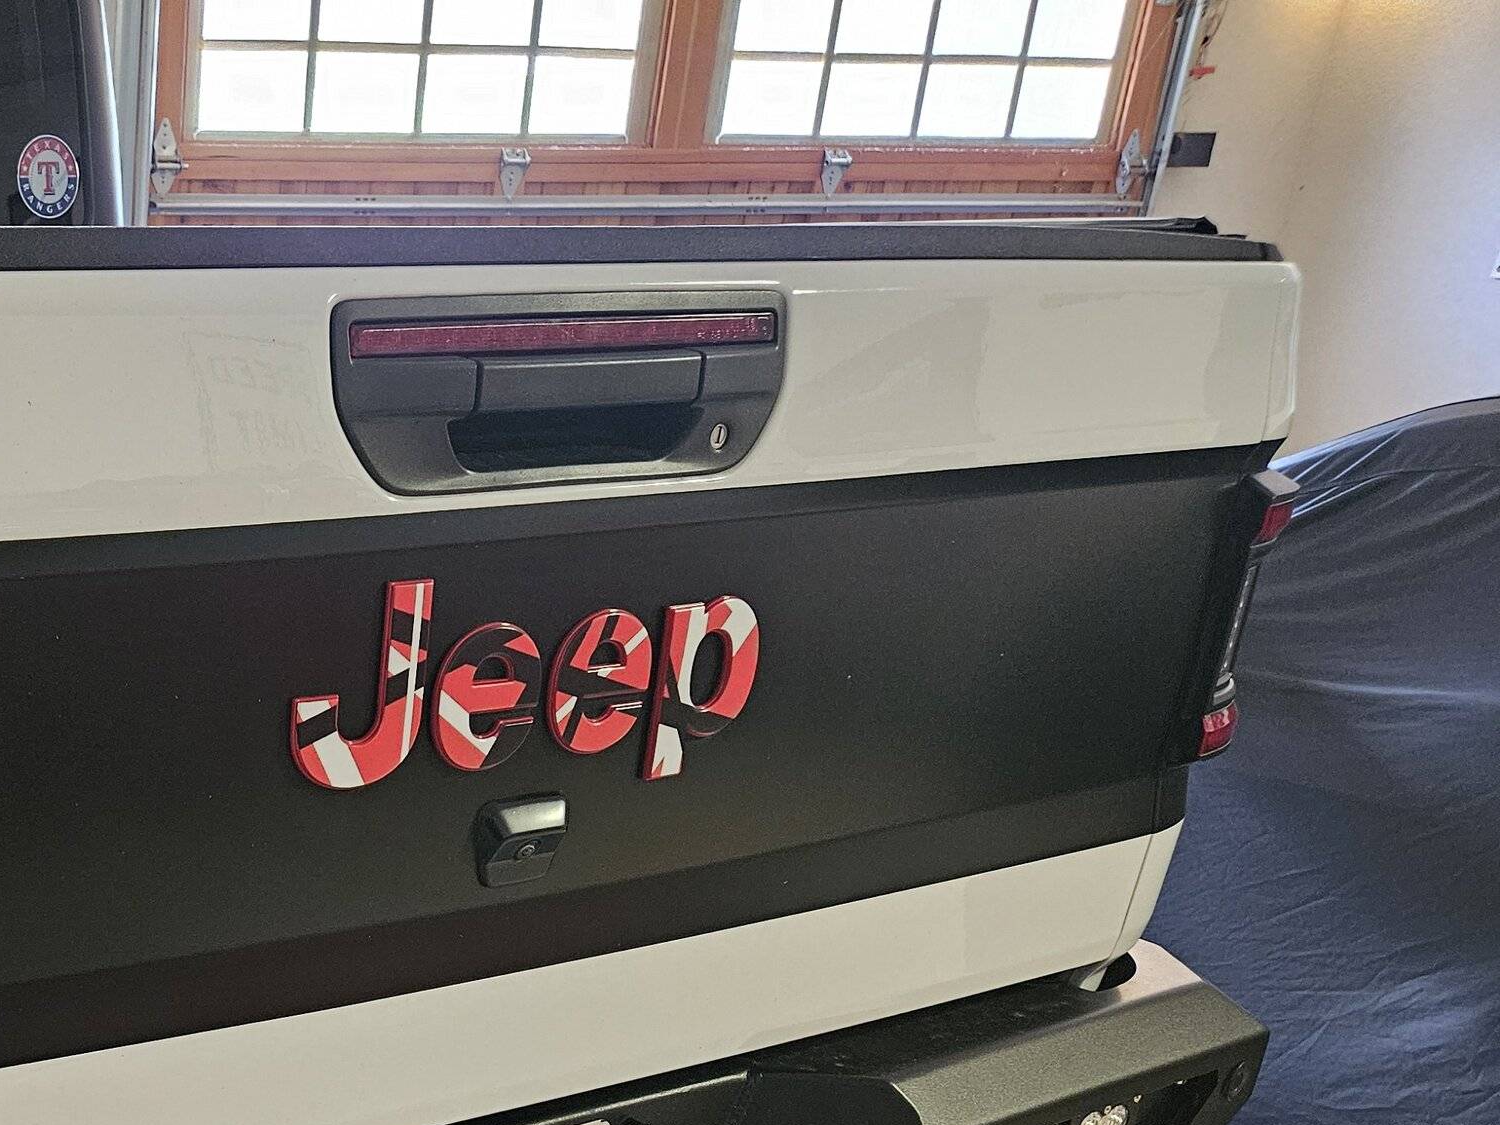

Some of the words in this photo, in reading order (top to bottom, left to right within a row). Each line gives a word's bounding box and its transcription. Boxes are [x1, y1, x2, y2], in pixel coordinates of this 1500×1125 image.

[21, 140, 69, 165] TEXAS
[37, 161, 60, 195] T
[22, 183, 75, 213] RANGERS
[288, 578, 760, 789] Jeep
